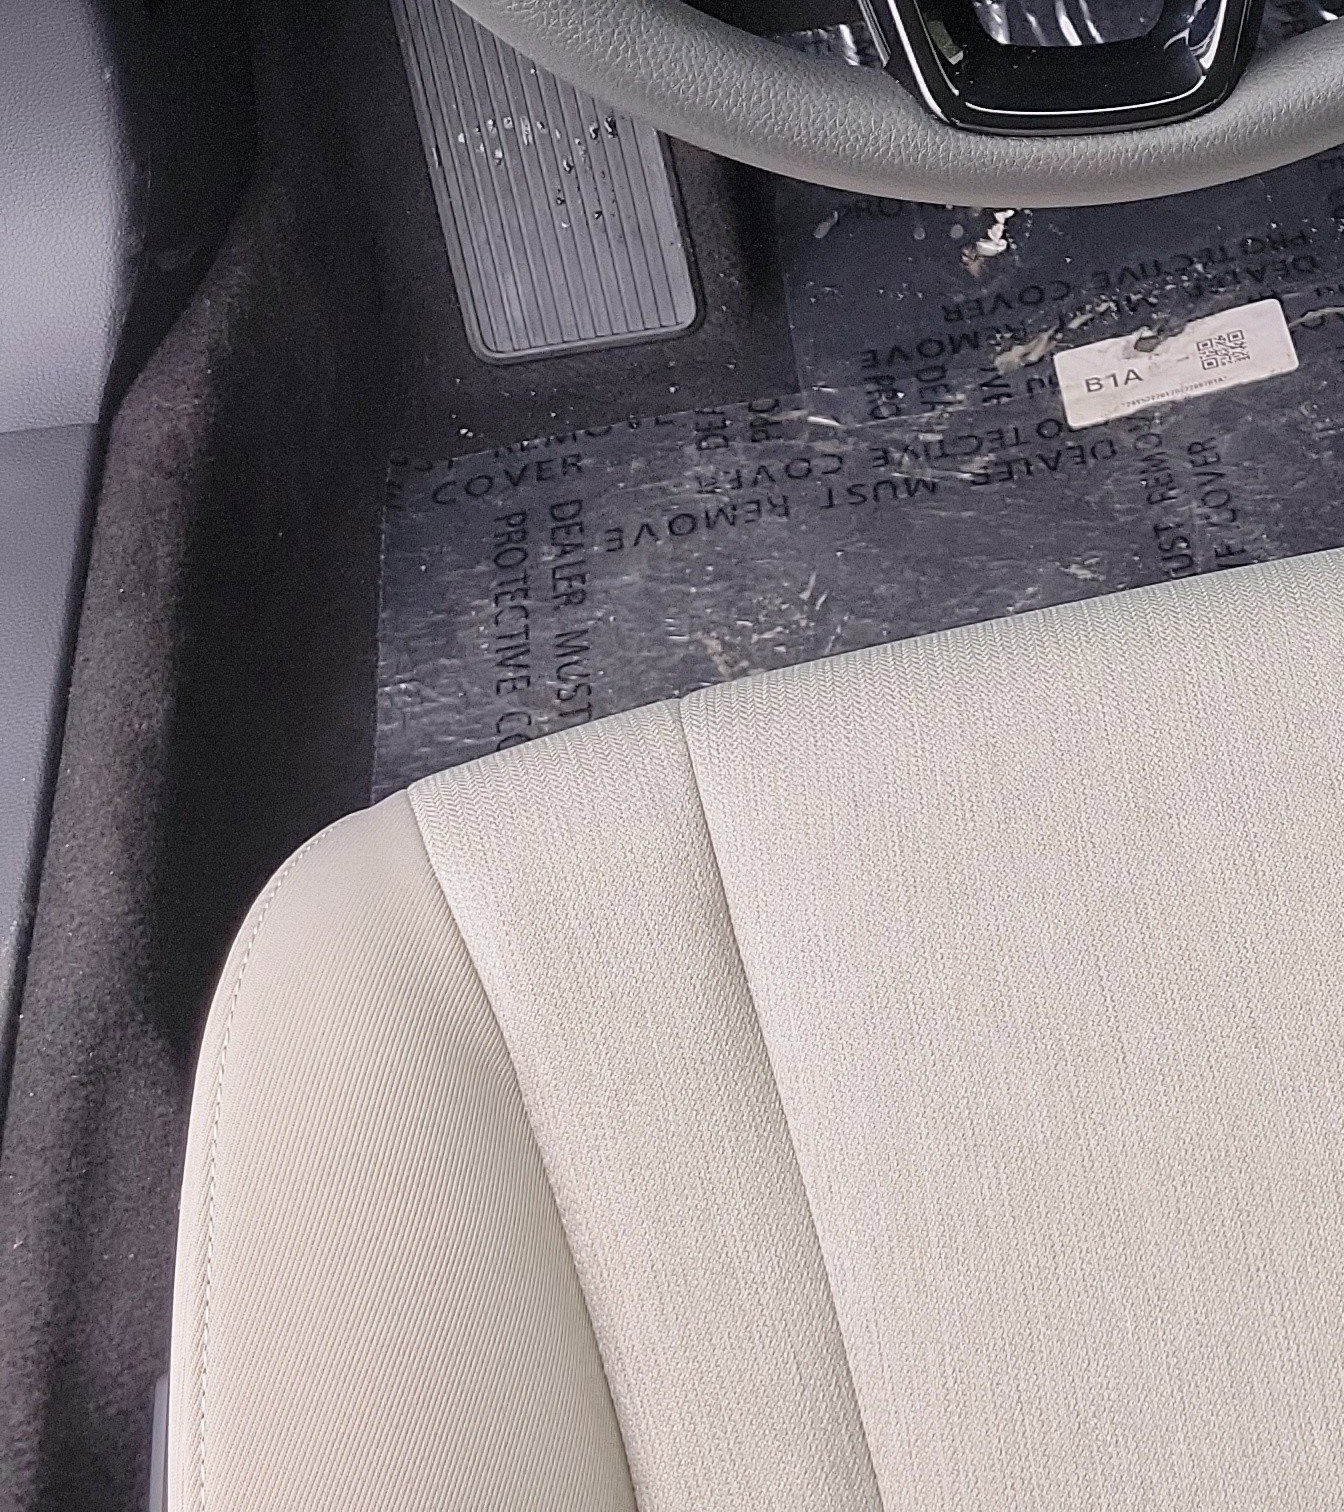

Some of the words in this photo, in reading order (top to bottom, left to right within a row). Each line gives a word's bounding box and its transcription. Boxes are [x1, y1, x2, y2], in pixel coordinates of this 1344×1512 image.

[1084, 368, 1144, 393] B1A
[432, 453, 583, 505] COVER
[820, 478, 938, 509] MUST
[604, 493, 791, 553] REMOVE
[550, 499, 587, 611] DEALER
[494, 510, 531, 695] PROTECTIVE
[555, 629, 593, 722] MUST
